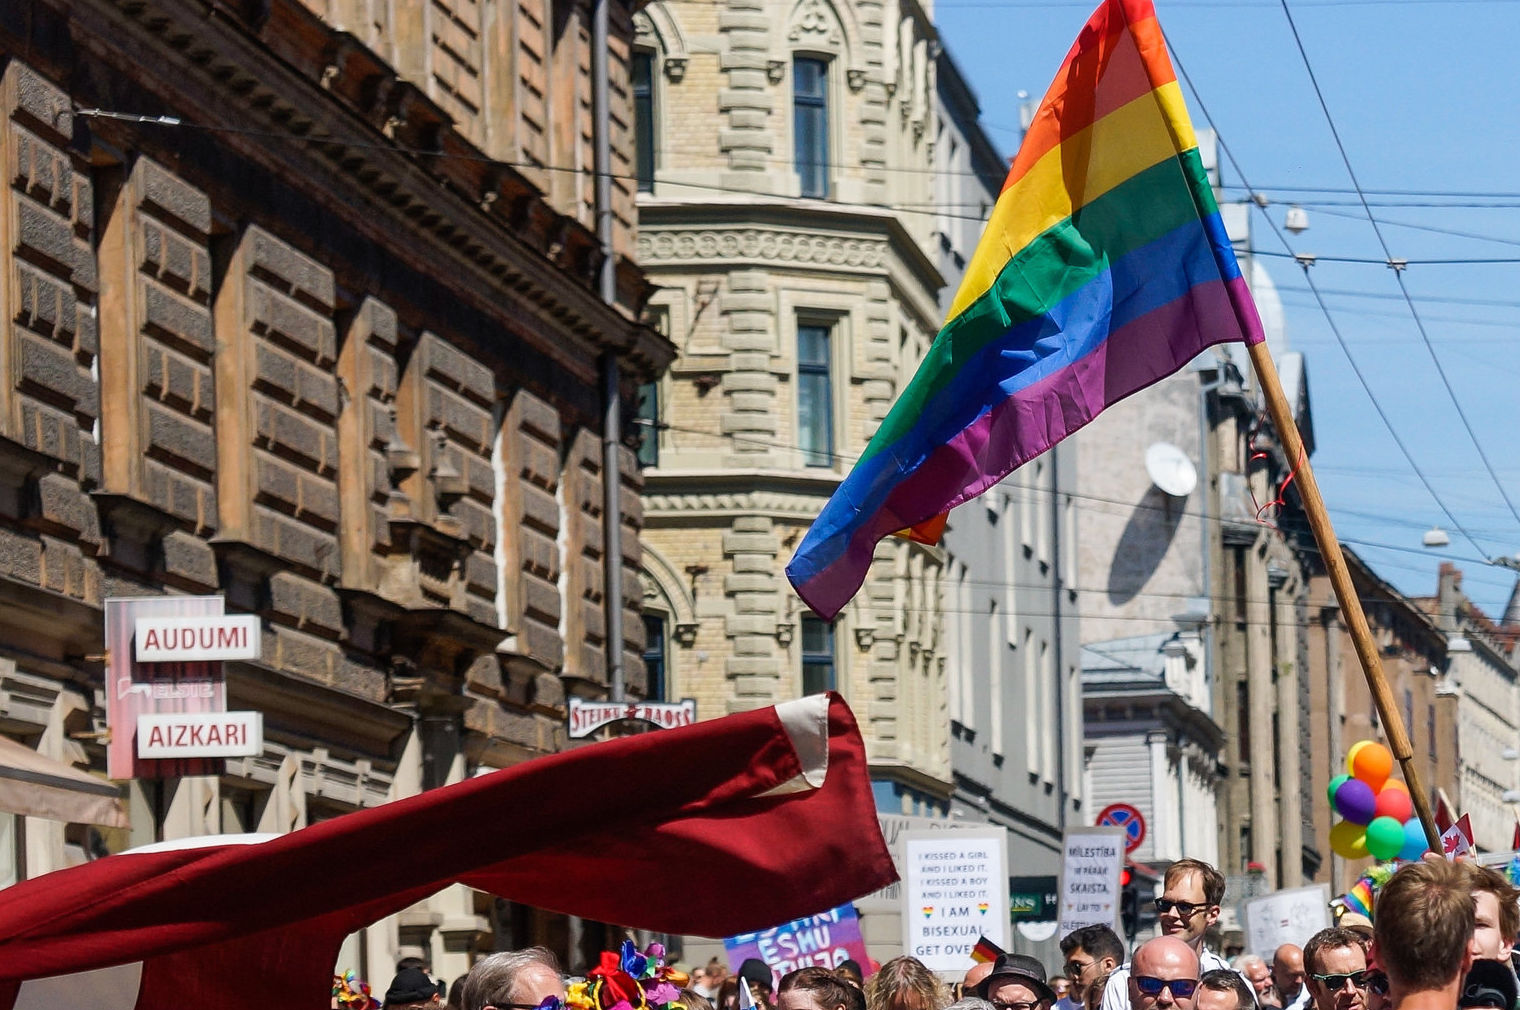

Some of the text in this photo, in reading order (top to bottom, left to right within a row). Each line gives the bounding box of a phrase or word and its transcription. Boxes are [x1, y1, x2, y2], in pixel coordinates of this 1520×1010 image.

[144, 626, 248, 651] AUDUMI
[148, 723, 247, 748] AIZKARI
[924, 852, 957, 860] KISSED
[967, 850, 989, 859] GIRL
[948, 864, 976, 873] LIKED
[926, 878, 958, 886] KISSED
[969, 877, 988, 886] BOY
[949, 890, 977, 899] LIKED
[949, 907, 970, 917] AM
[758, 925, 831, 966] ESMU
[916, 945, 976, 956] GET OVE
